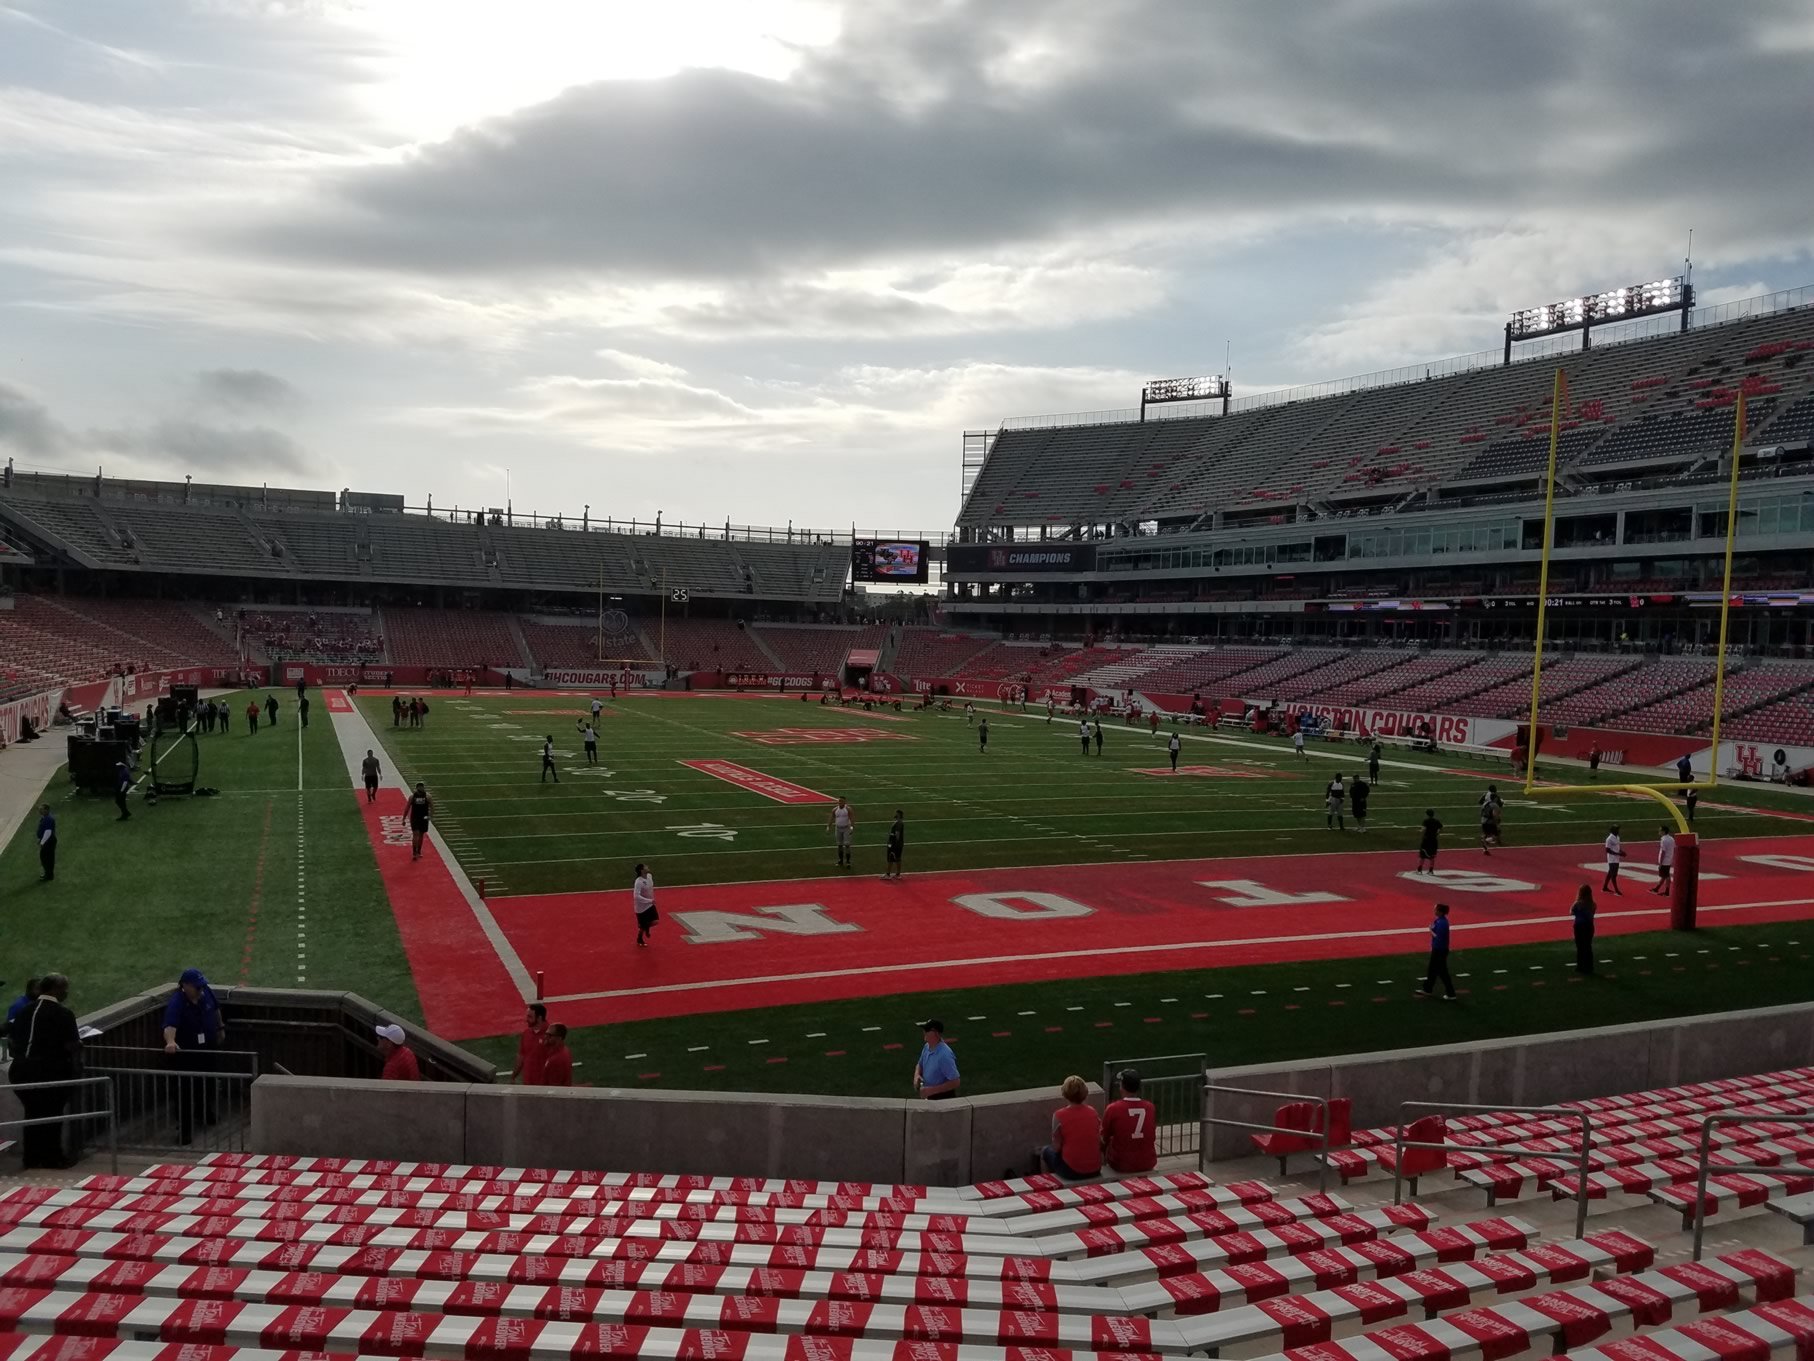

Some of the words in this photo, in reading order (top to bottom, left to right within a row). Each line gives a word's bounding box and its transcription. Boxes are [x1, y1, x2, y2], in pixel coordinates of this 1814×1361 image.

[1008, 553, 1071, 565] CHAMPIONS
[672, 589, 688, 600] 25
[326, 667, 360, 677] TDECU
[1127, 1108, 1146, 1140] 7
